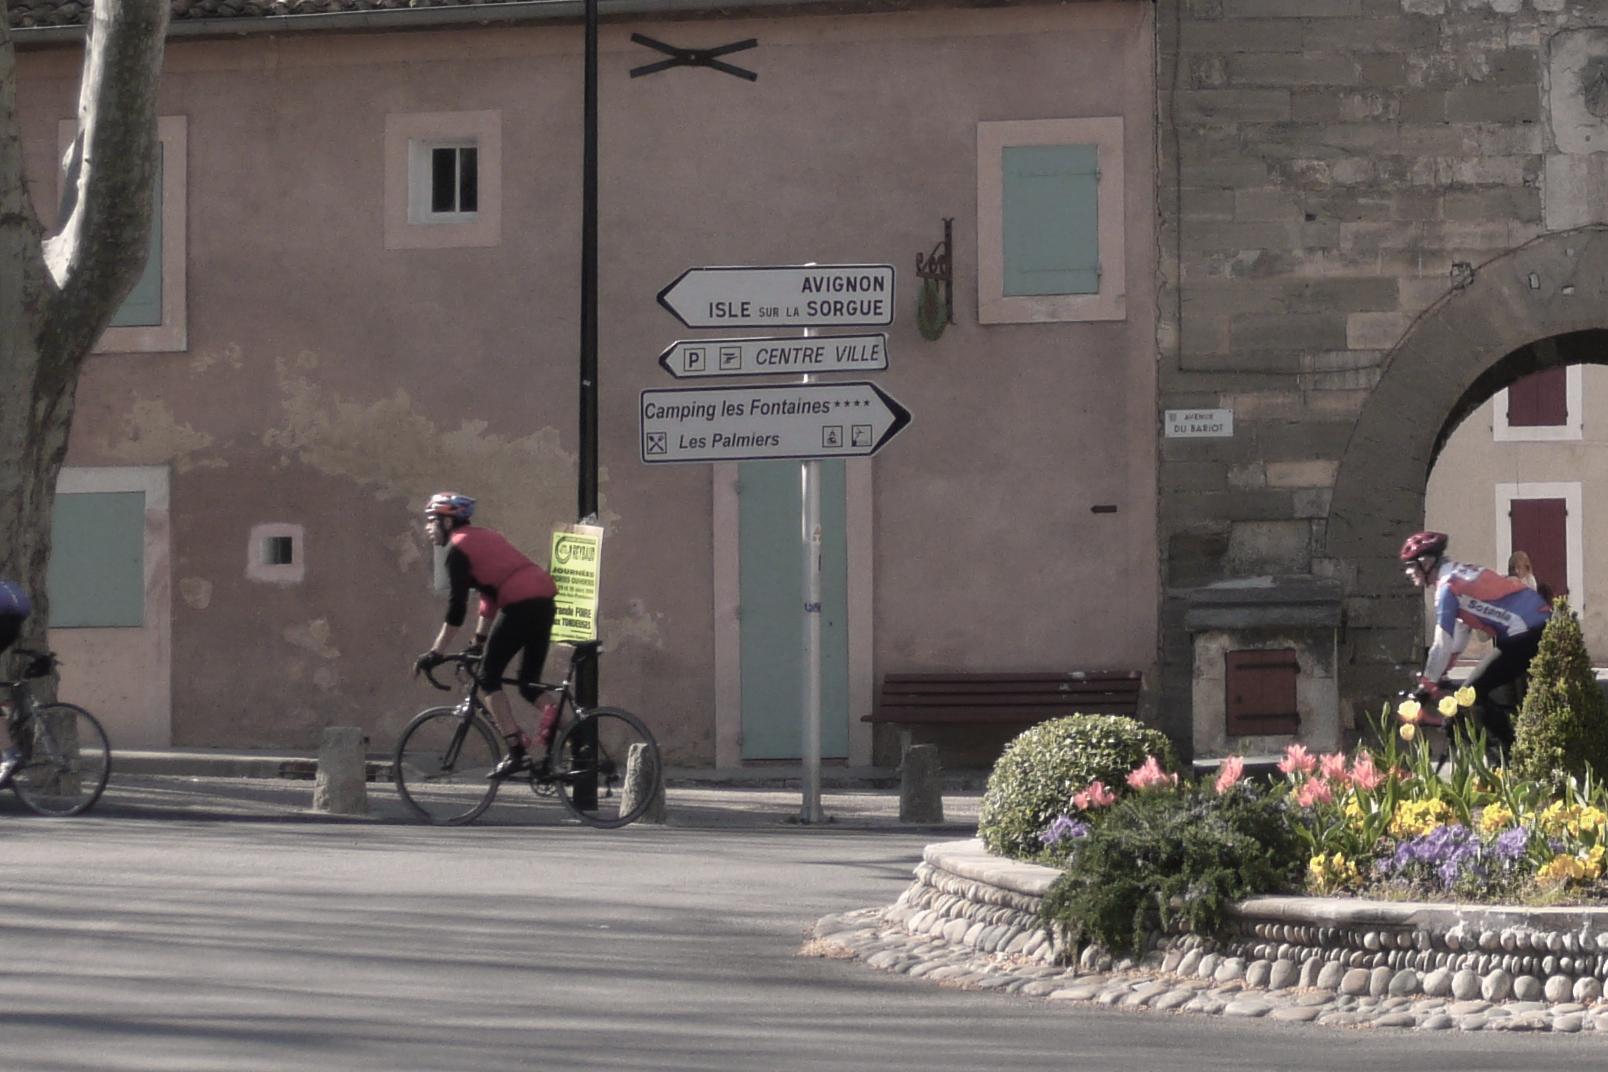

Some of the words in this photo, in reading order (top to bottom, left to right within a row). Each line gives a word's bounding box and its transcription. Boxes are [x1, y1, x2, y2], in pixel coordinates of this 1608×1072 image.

[801, 276, 885, 293] AVIGNON
[708, 301, 752, 318] ISLE
[758, 306, 780, 318] SUR
[785, 306, 800, 318] LA
[806, 299, 884, 317] SORGUE
[755, 346, 825, 366] CENTRE
[834, 344, 880, 362] VILLE
[644, 401, 716, 422] Camping
[720, 400, 745, 417] les
[749, 396, 831, 416] Fontaines
[1173, 424, 1187, 433] DU
[678, 433, 708, 449] Les
[711, 431, 780, 448] Palmiers
